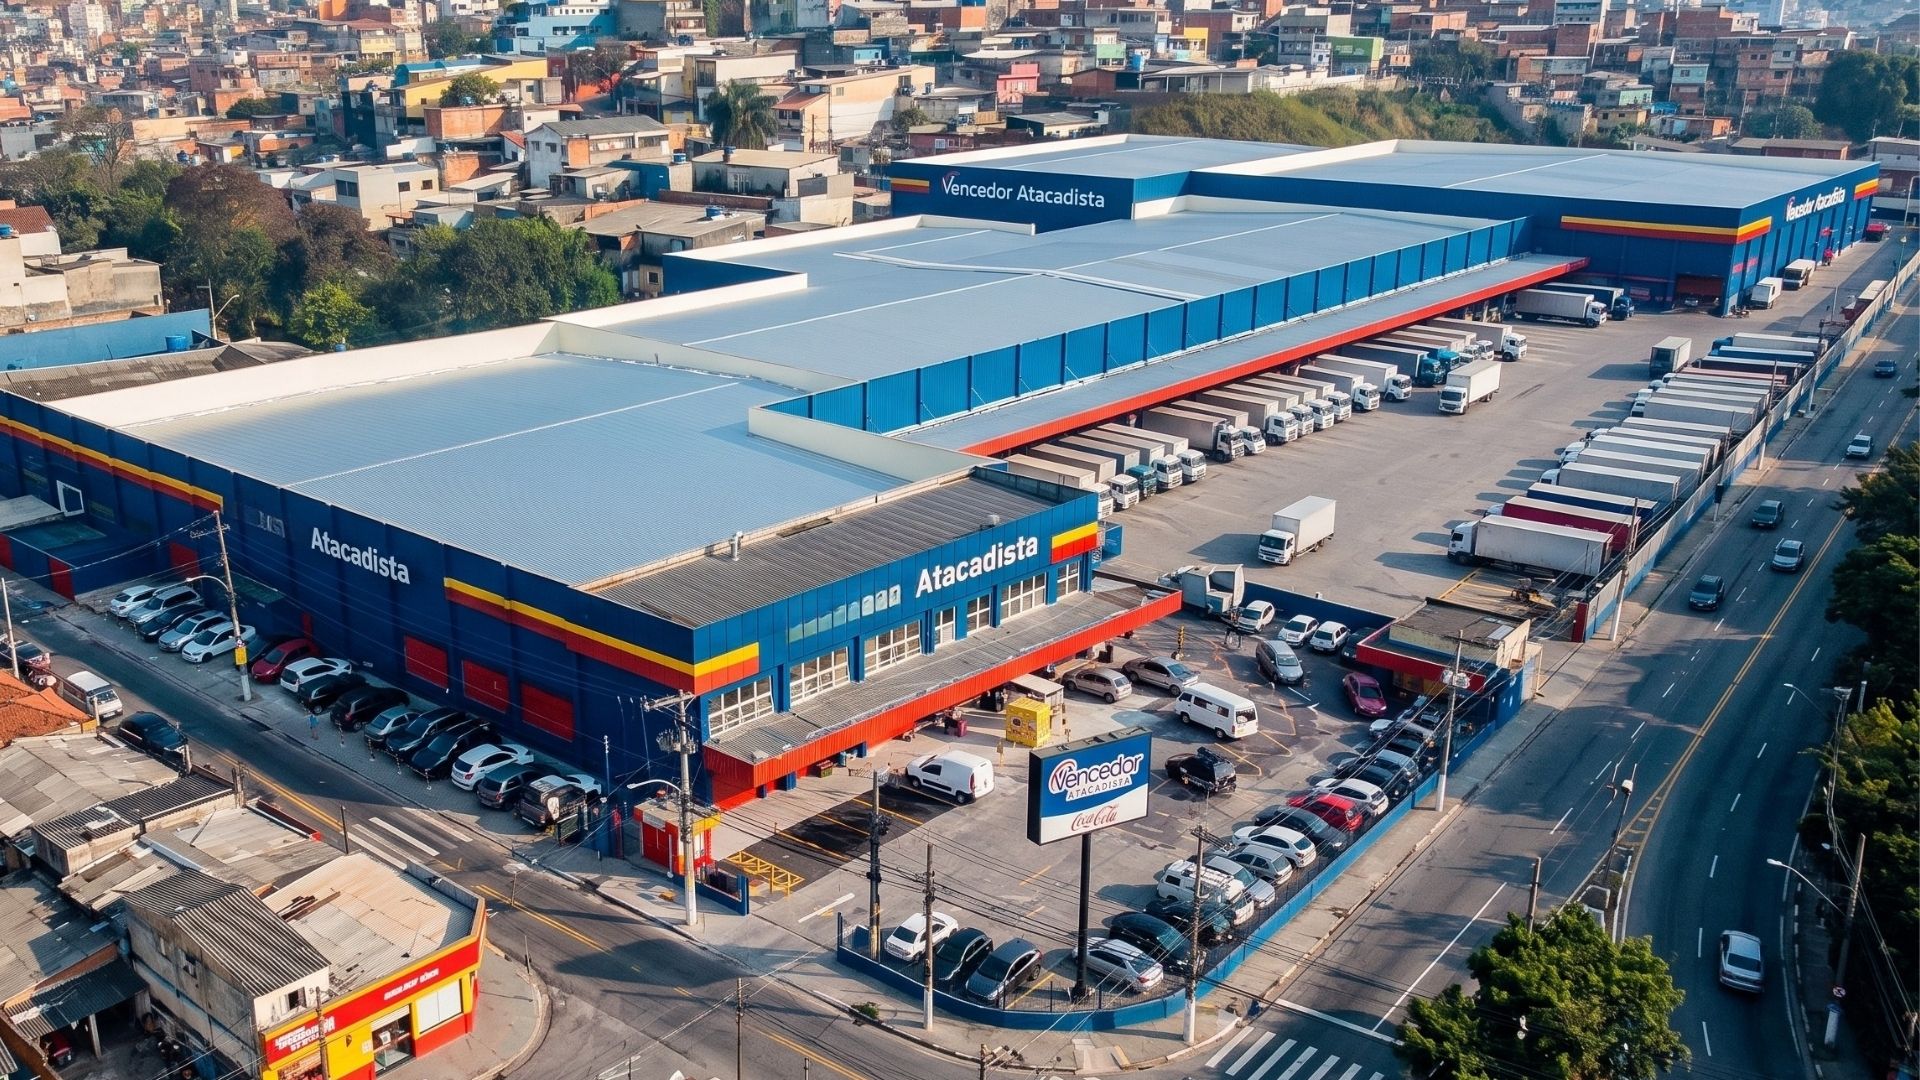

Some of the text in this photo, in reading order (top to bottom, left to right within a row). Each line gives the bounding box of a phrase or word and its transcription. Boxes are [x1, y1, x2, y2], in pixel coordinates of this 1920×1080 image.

[942, 174, 1105, 208] Vencedor Atacadista
[311, 527, 411, 585] Atacadista
[915, 536, 1038, 598] Atacadista
[1050, 754, 1142, 792] Vencedor
[1067, 777, 1130, 800] ATACADISTA
